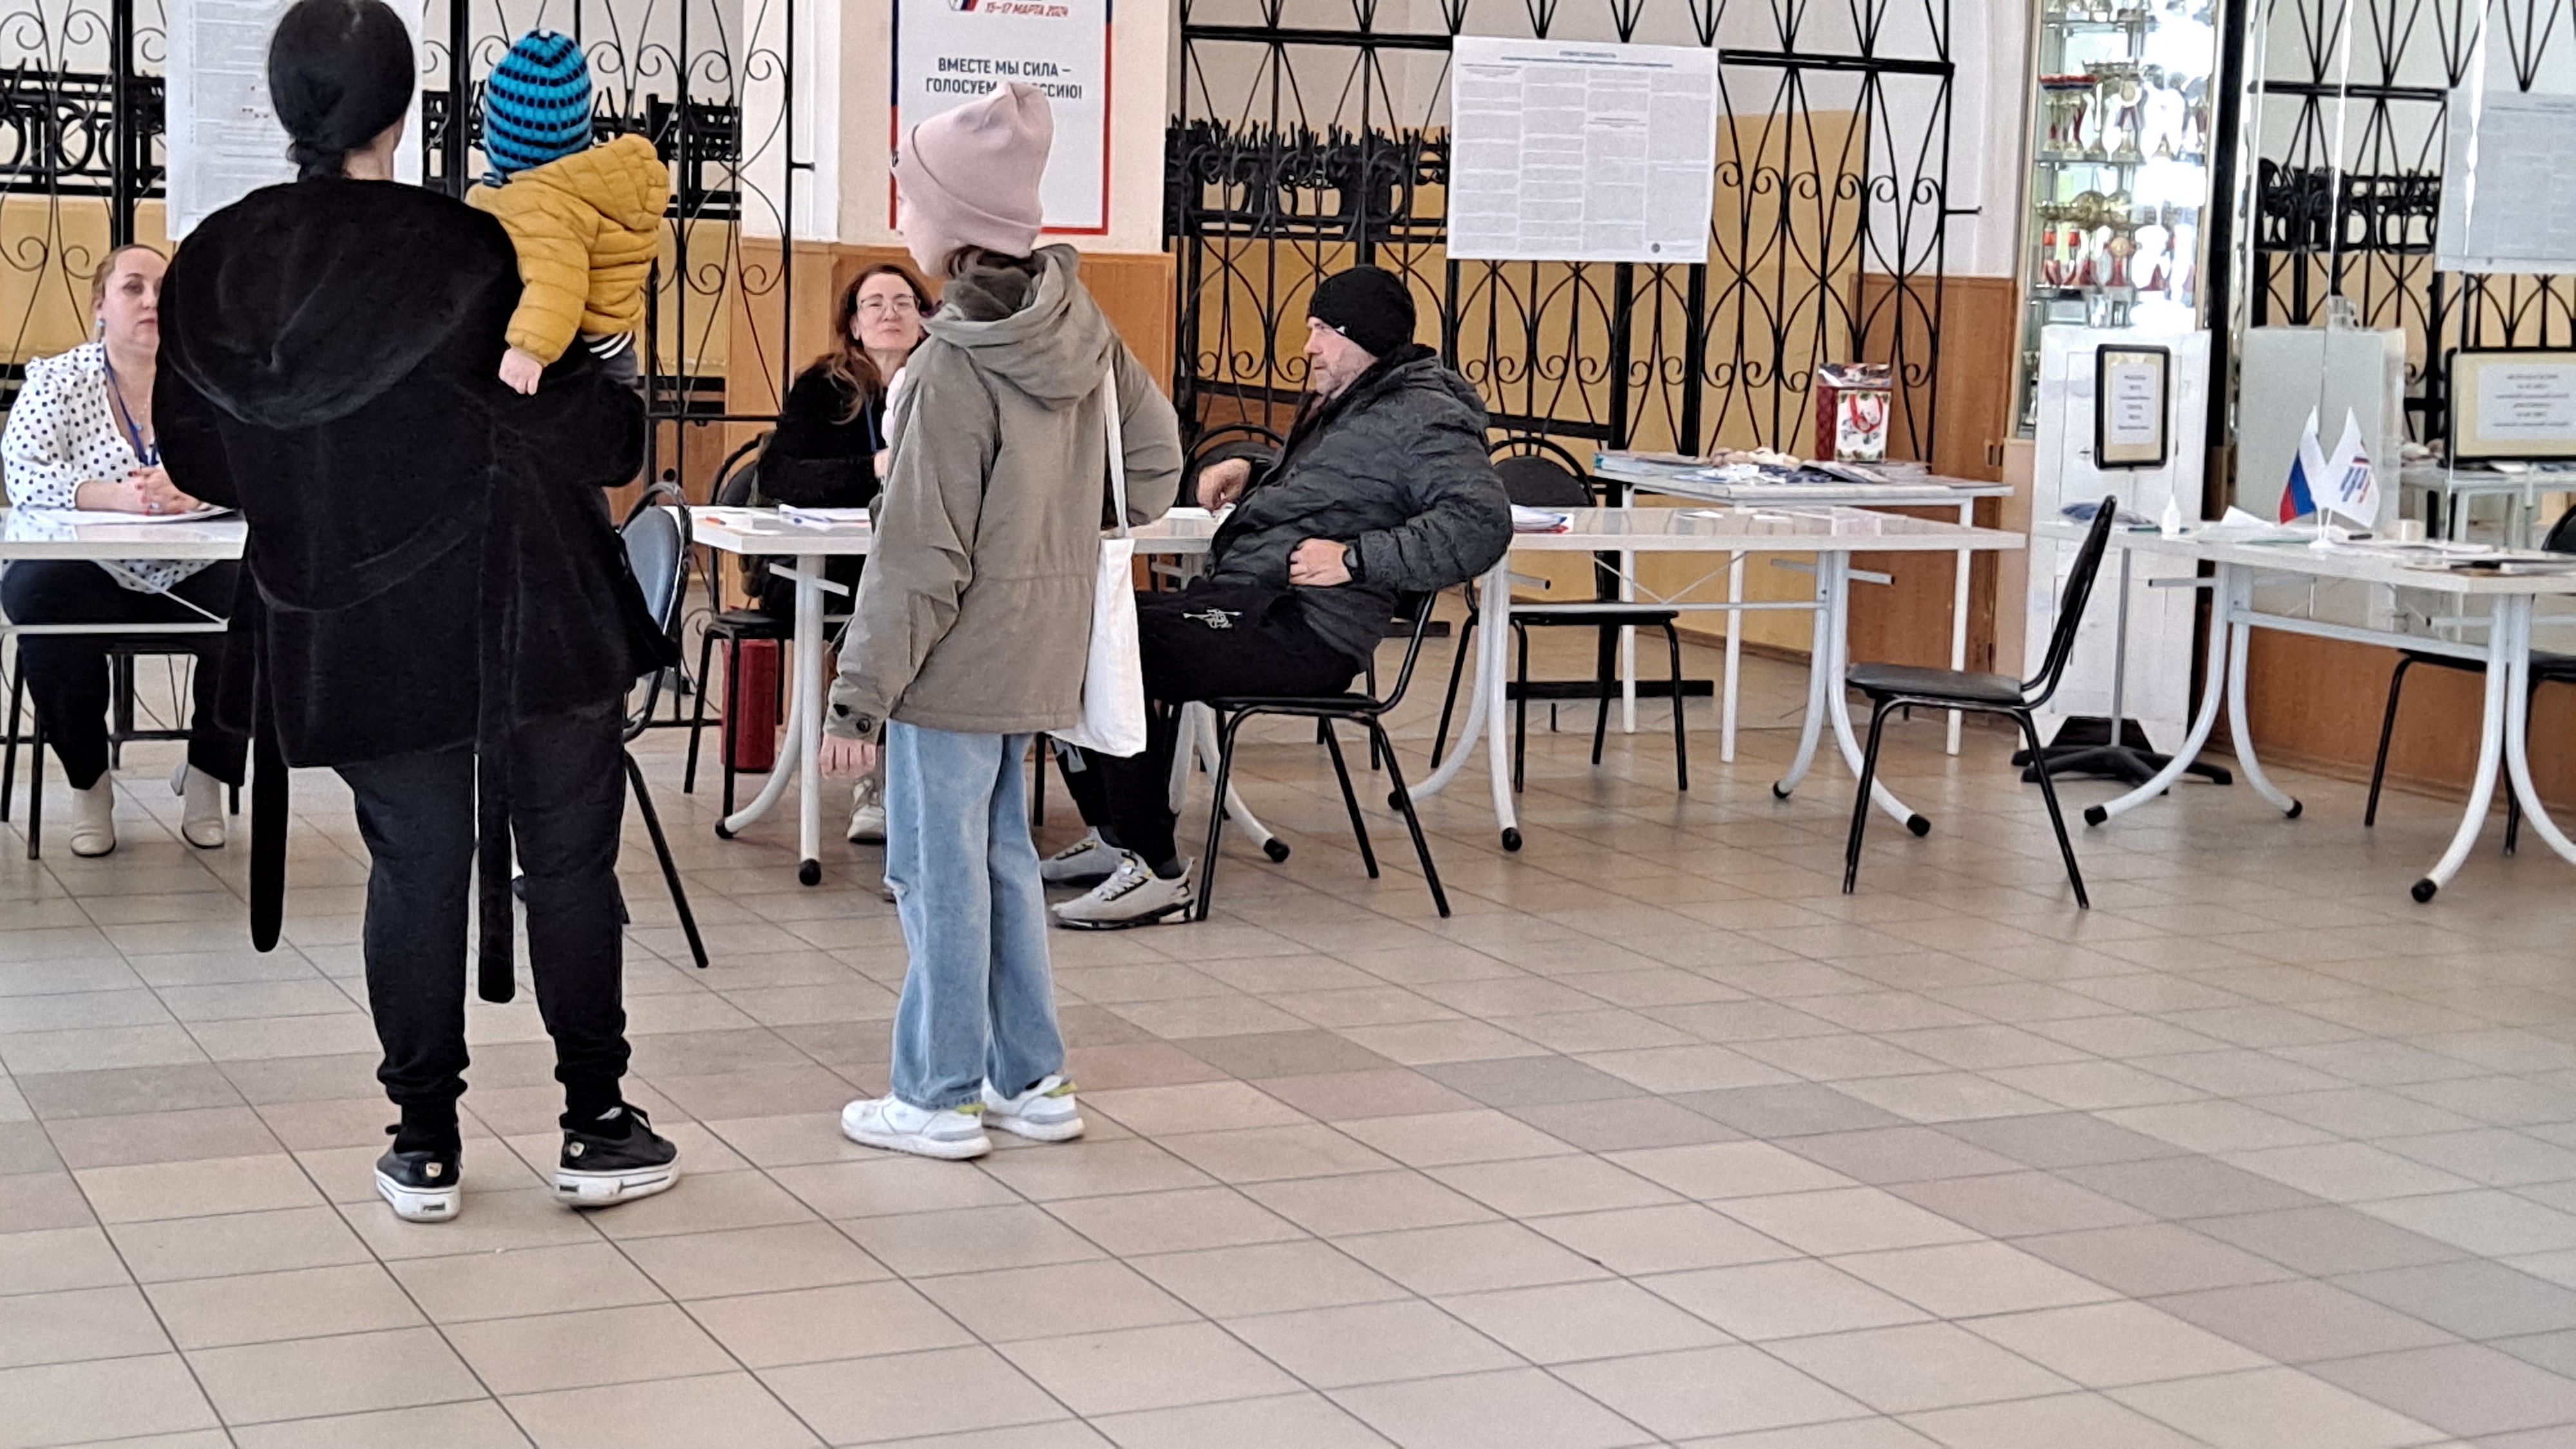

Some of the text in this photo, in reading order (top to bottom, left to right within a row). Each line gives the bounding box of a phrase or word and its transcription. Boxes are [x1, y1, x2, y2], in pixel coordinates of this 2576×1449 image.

[1011, 4, 1044, 15] МАРТА
[938, 57, 991, 73] ВМЕСТЕ
[995, 60, 1019, 75] МЫ
[1023, 61, 1059, 77] СИЛА
[926, 77, 998, 95] ГОЛОСУЕМ
